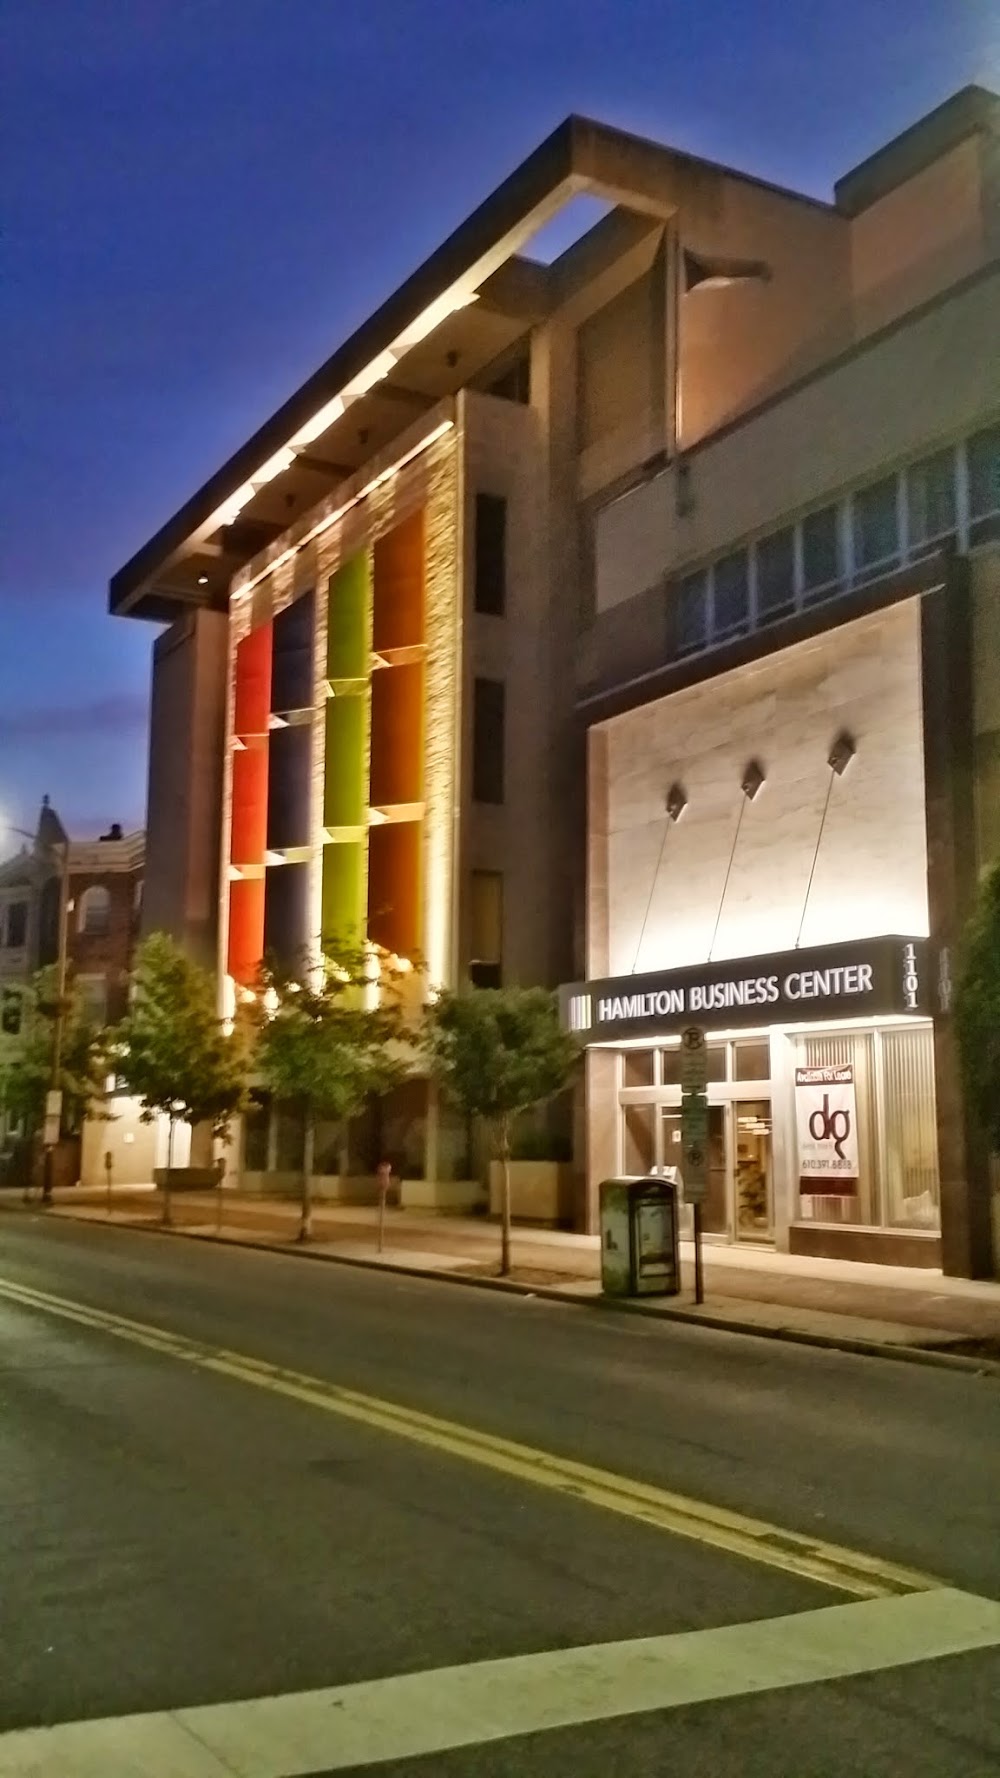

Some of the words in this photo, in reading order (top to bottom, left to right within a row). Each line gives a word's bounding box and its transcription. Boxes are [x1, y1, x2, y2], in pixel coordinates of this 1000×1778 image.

[597, 988, 685, 1022] HAMILTON
[688, 975, 780, 1012] BUSINESS
[783, 963, 874, 1000] CENTER
[902, 943, 919, 1009] 1101
